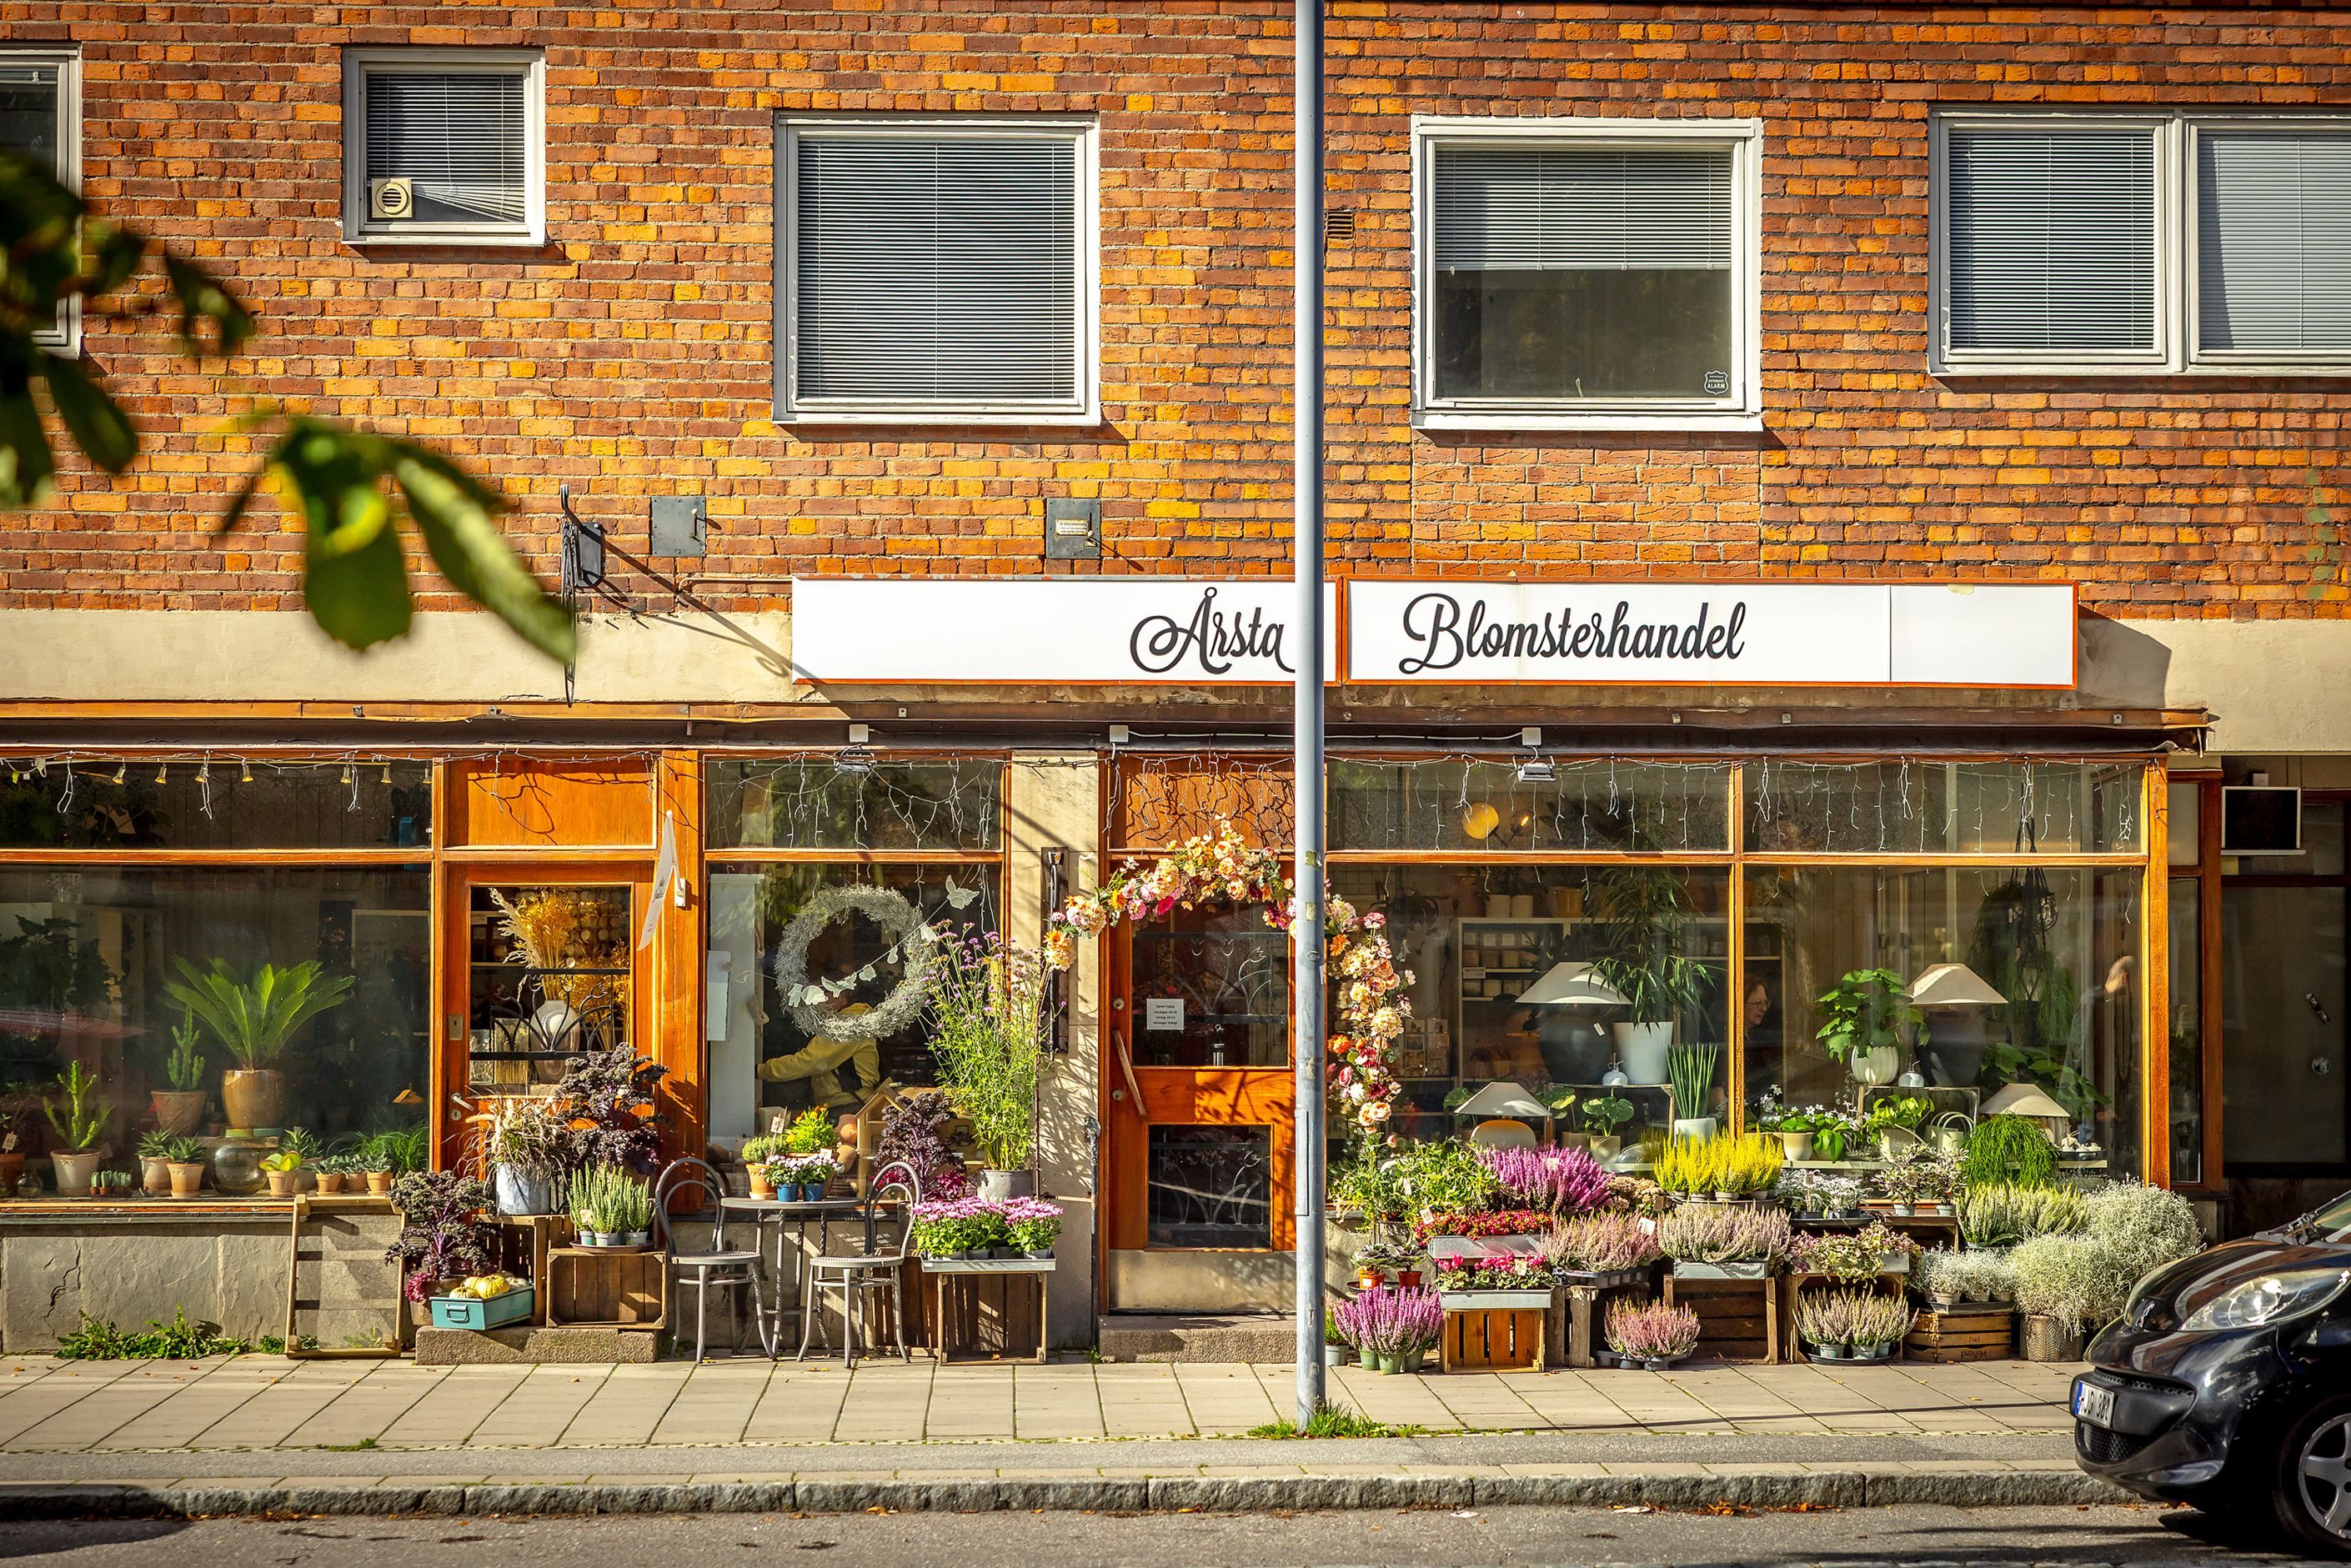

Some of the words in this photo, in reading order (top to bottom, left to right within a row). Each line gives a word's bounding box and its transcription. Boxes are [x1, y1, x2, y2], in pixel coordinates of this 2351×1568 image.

[1130, 586, 1295, 674] Årsta
[1398, 593, 1746, 674] Blomsterhandel
[1961, 1350, 1987, 1358] Holland
